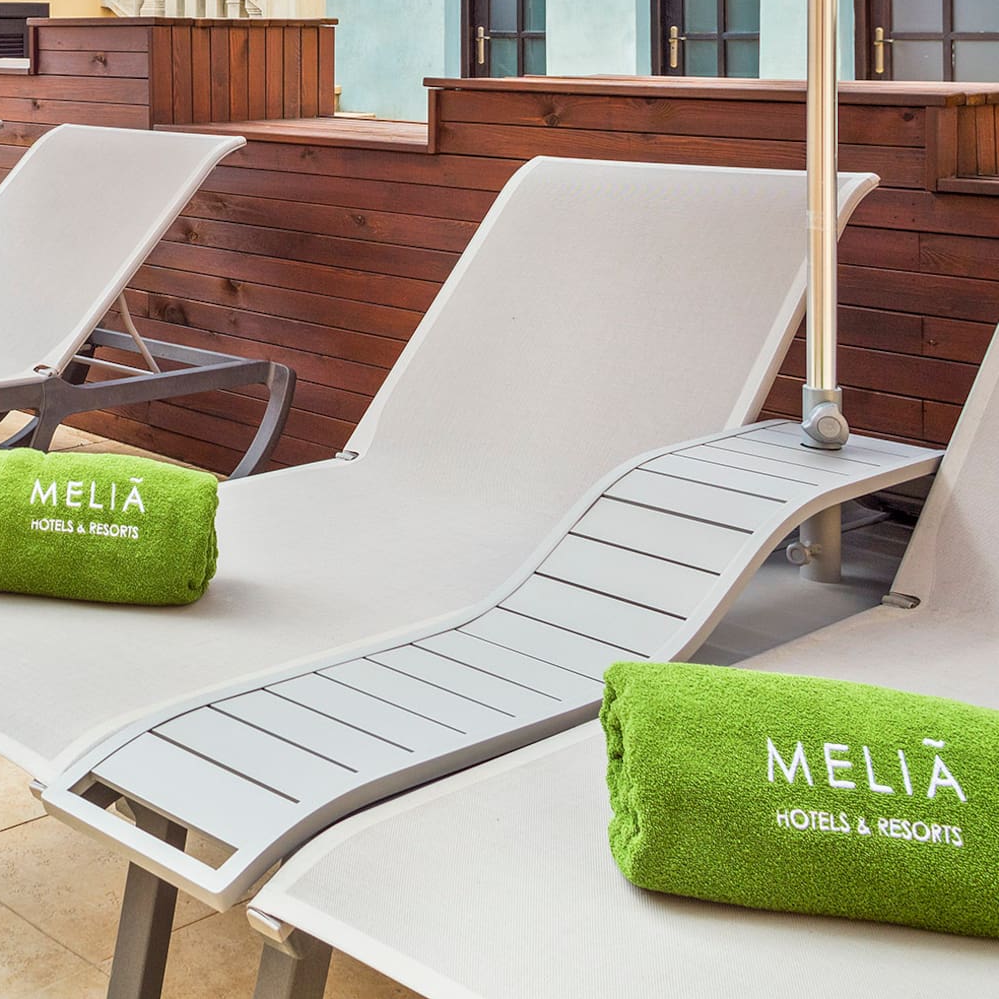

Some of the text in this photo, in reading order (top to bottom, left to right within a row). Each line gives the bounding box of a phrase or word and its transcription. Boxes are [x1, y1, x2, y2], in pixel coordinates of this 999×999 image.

[31, 518, 139, 540] HOTELS & RESORTS
[776, 808, 964, 848] HOTELS & RESORTS
